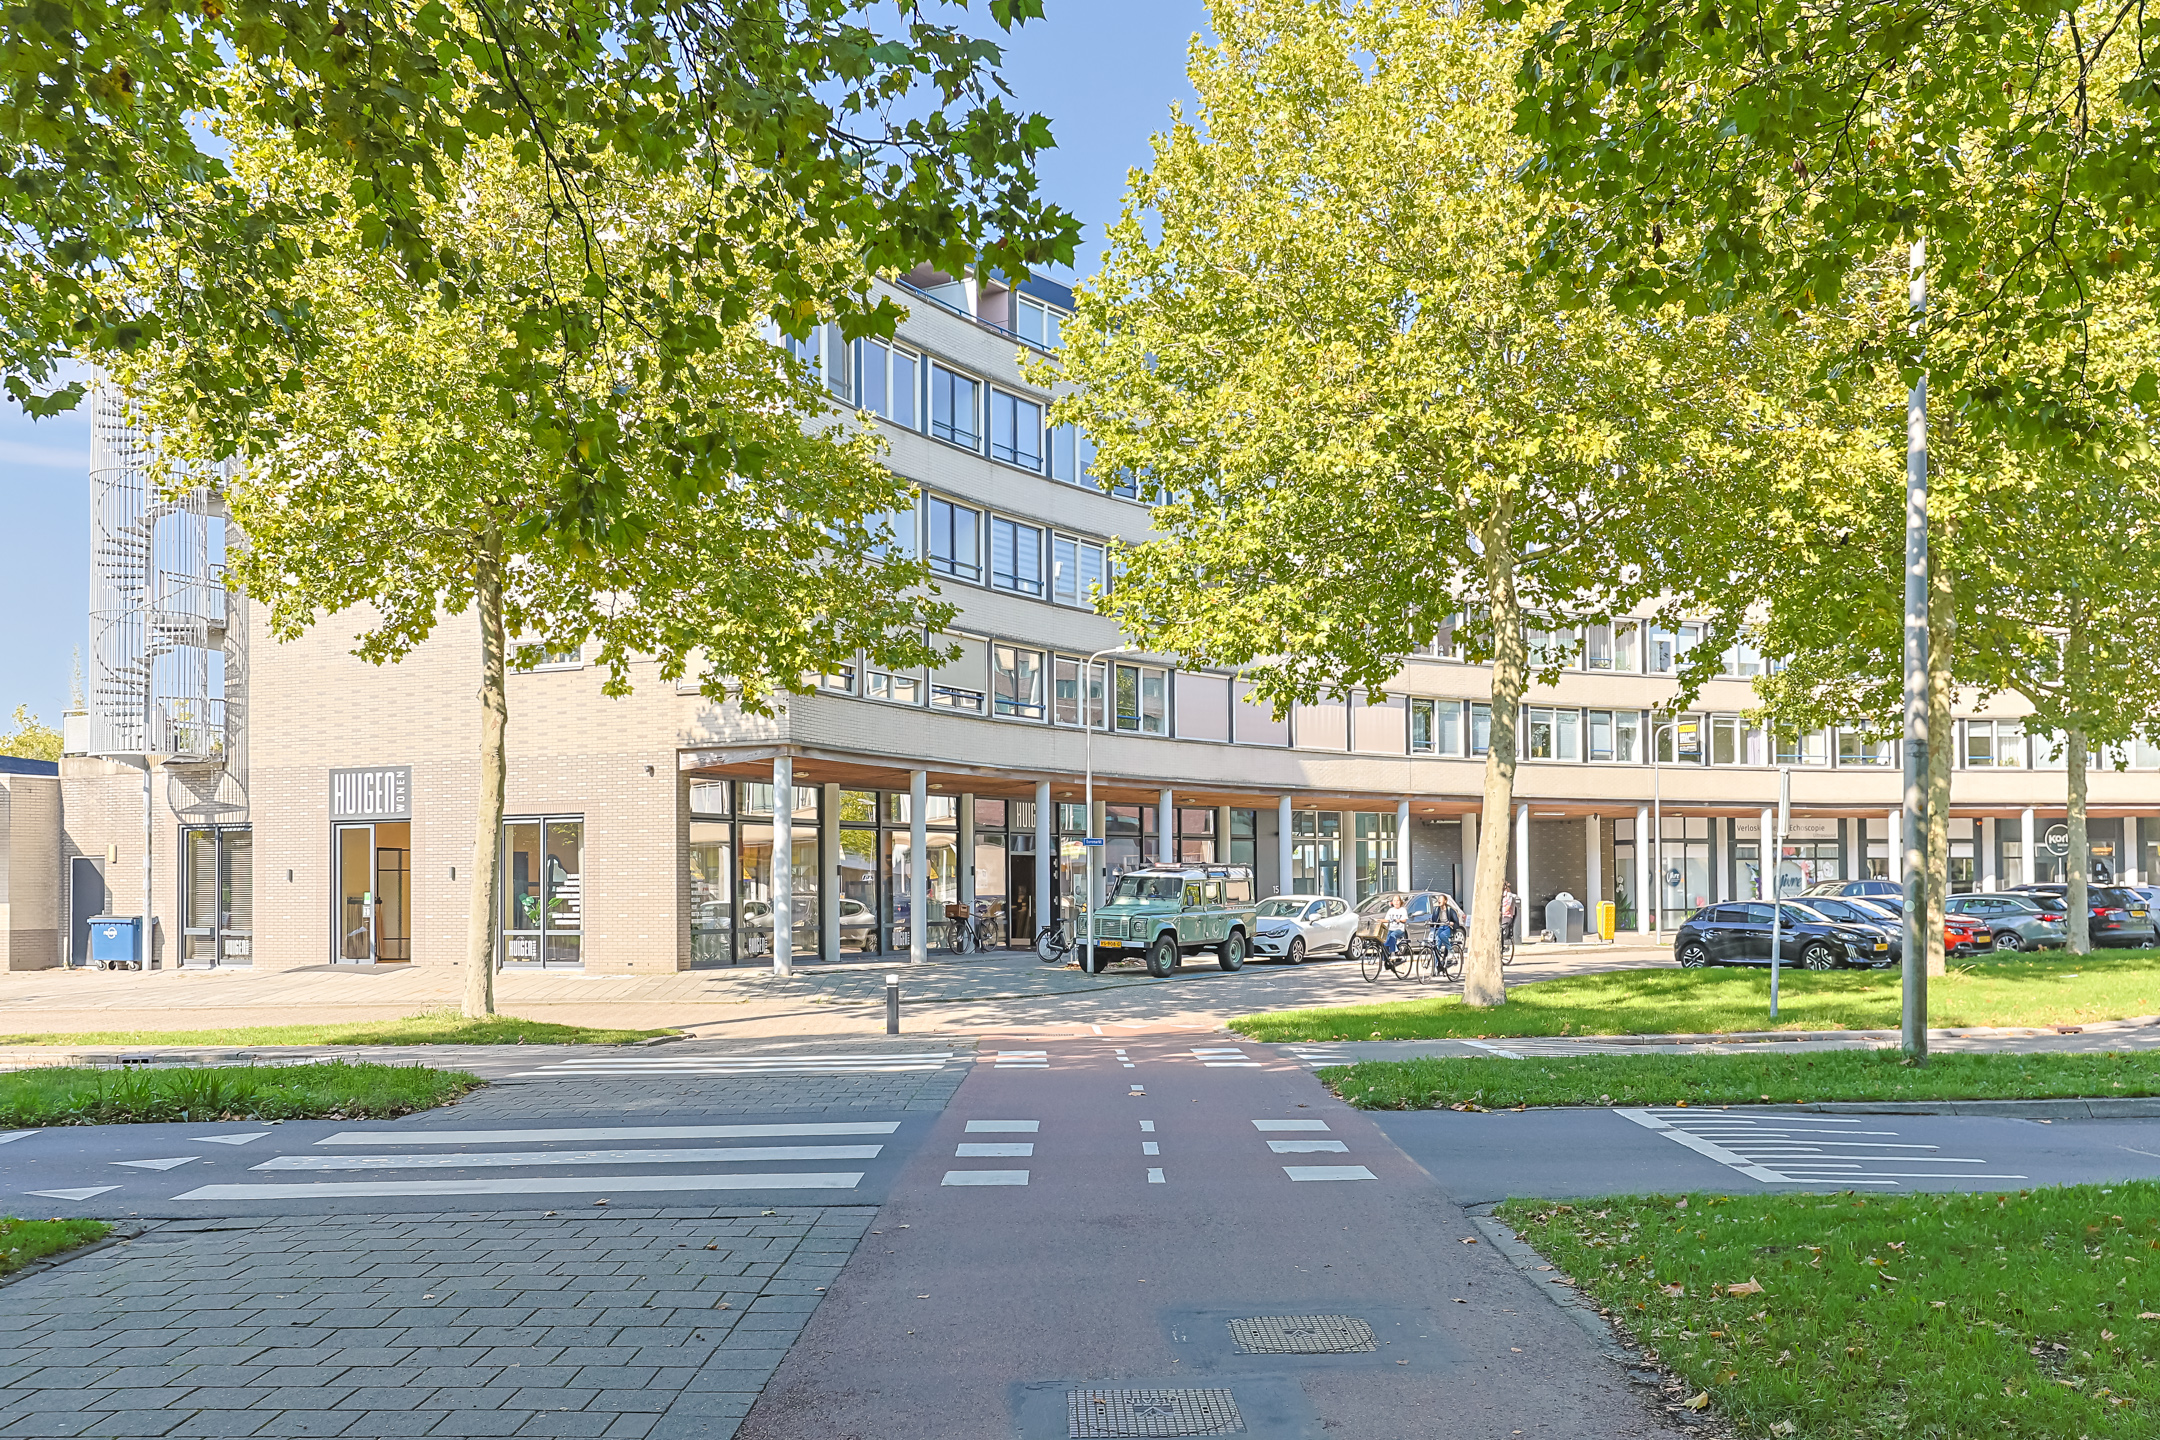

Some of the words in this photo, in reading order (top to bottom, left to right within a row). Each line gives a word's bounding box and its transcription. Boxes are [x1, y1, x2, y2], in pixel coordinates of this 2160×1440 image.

[334, 772, 395, 815] HUIGEN
[396, 771, 405, 813] WONEN
[1016, 801, 1036, 828] HUIG
[1737, 824, 1777, 832] Verloske
[1790, 824, 1825, 832] Echoscopie
[1272, 885, 1279, 894] 15
[508, 940, 532, 956] HUIGEN
